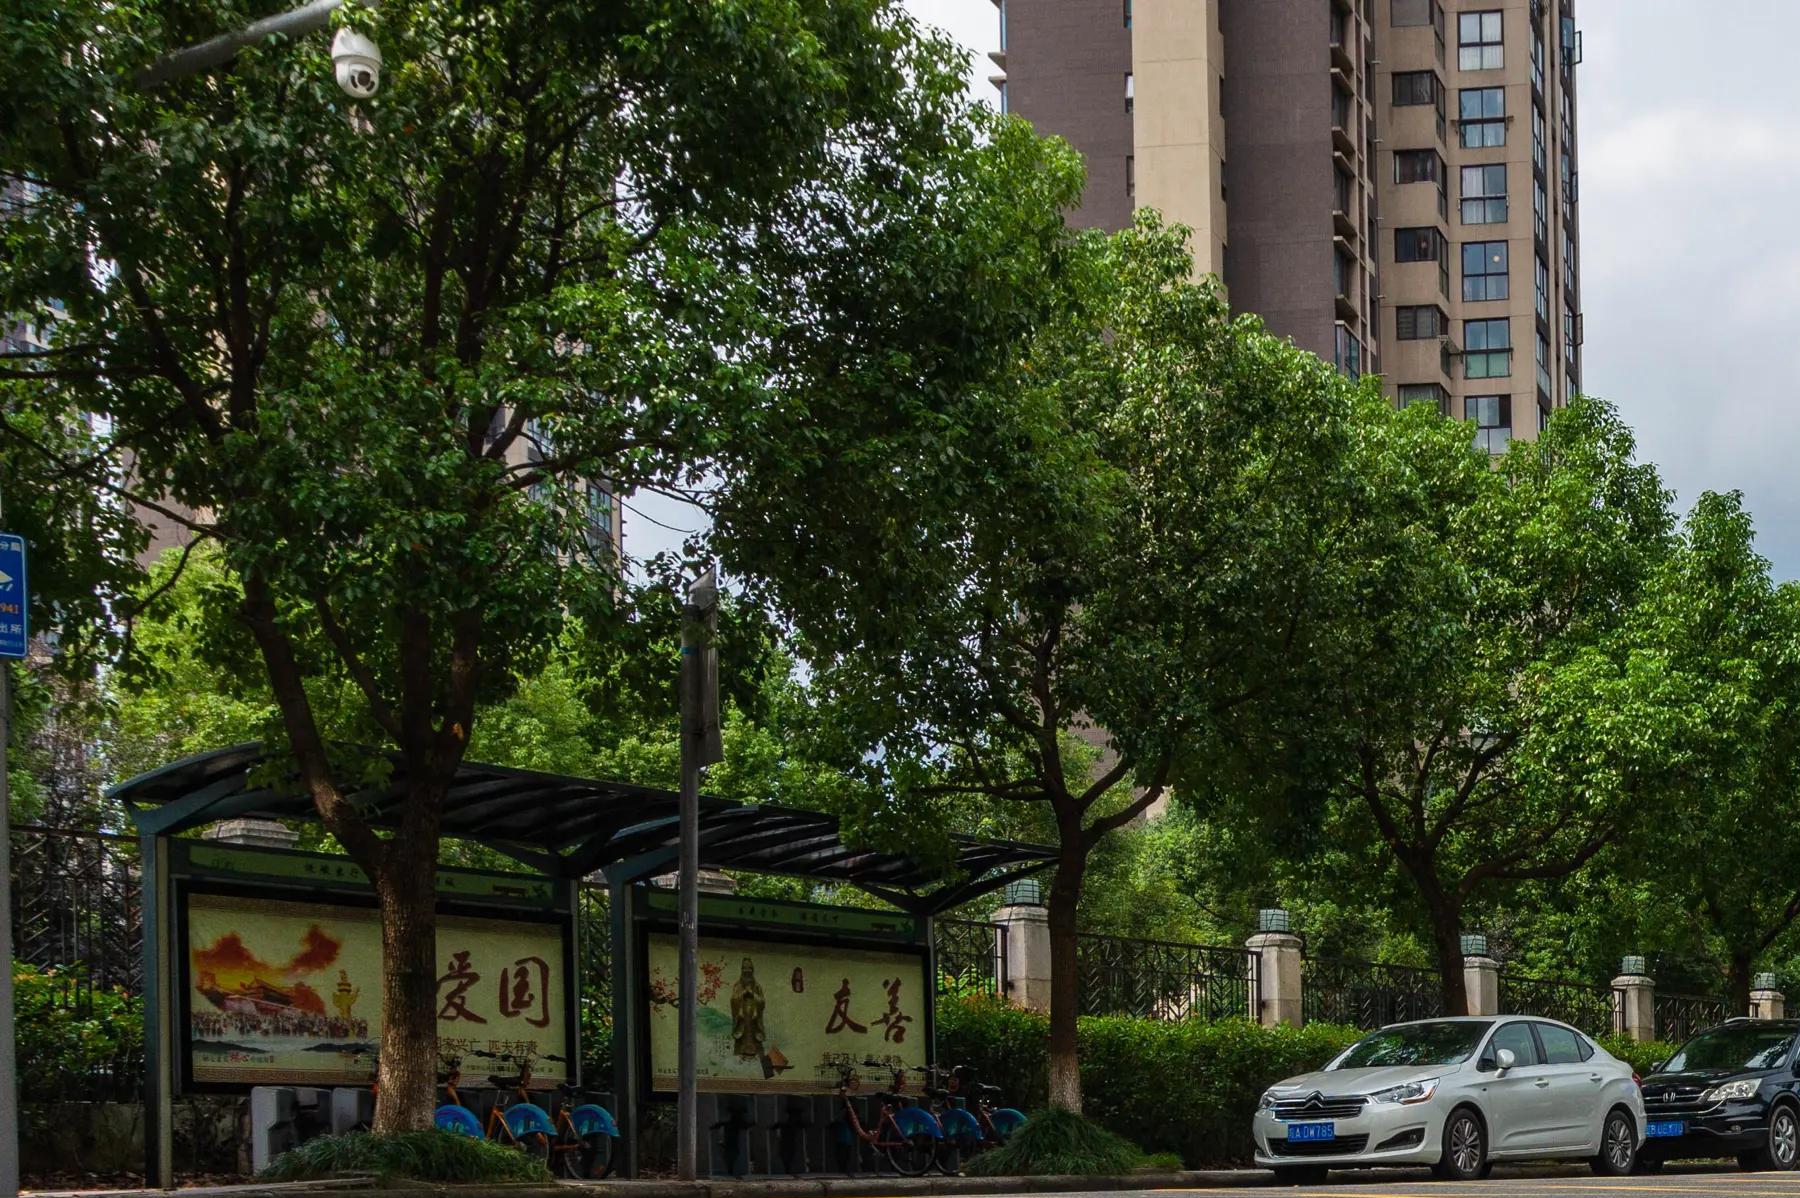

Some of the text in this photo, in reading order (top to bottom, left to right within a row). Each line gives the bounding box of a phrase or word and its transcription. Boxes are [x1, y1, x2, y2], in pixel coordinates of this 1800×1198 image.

[436, 950, 550, 1029] 爱国
[825, 977, 913, 1044] 友善
[436, 1036, 481, 1052] 家兴亡
